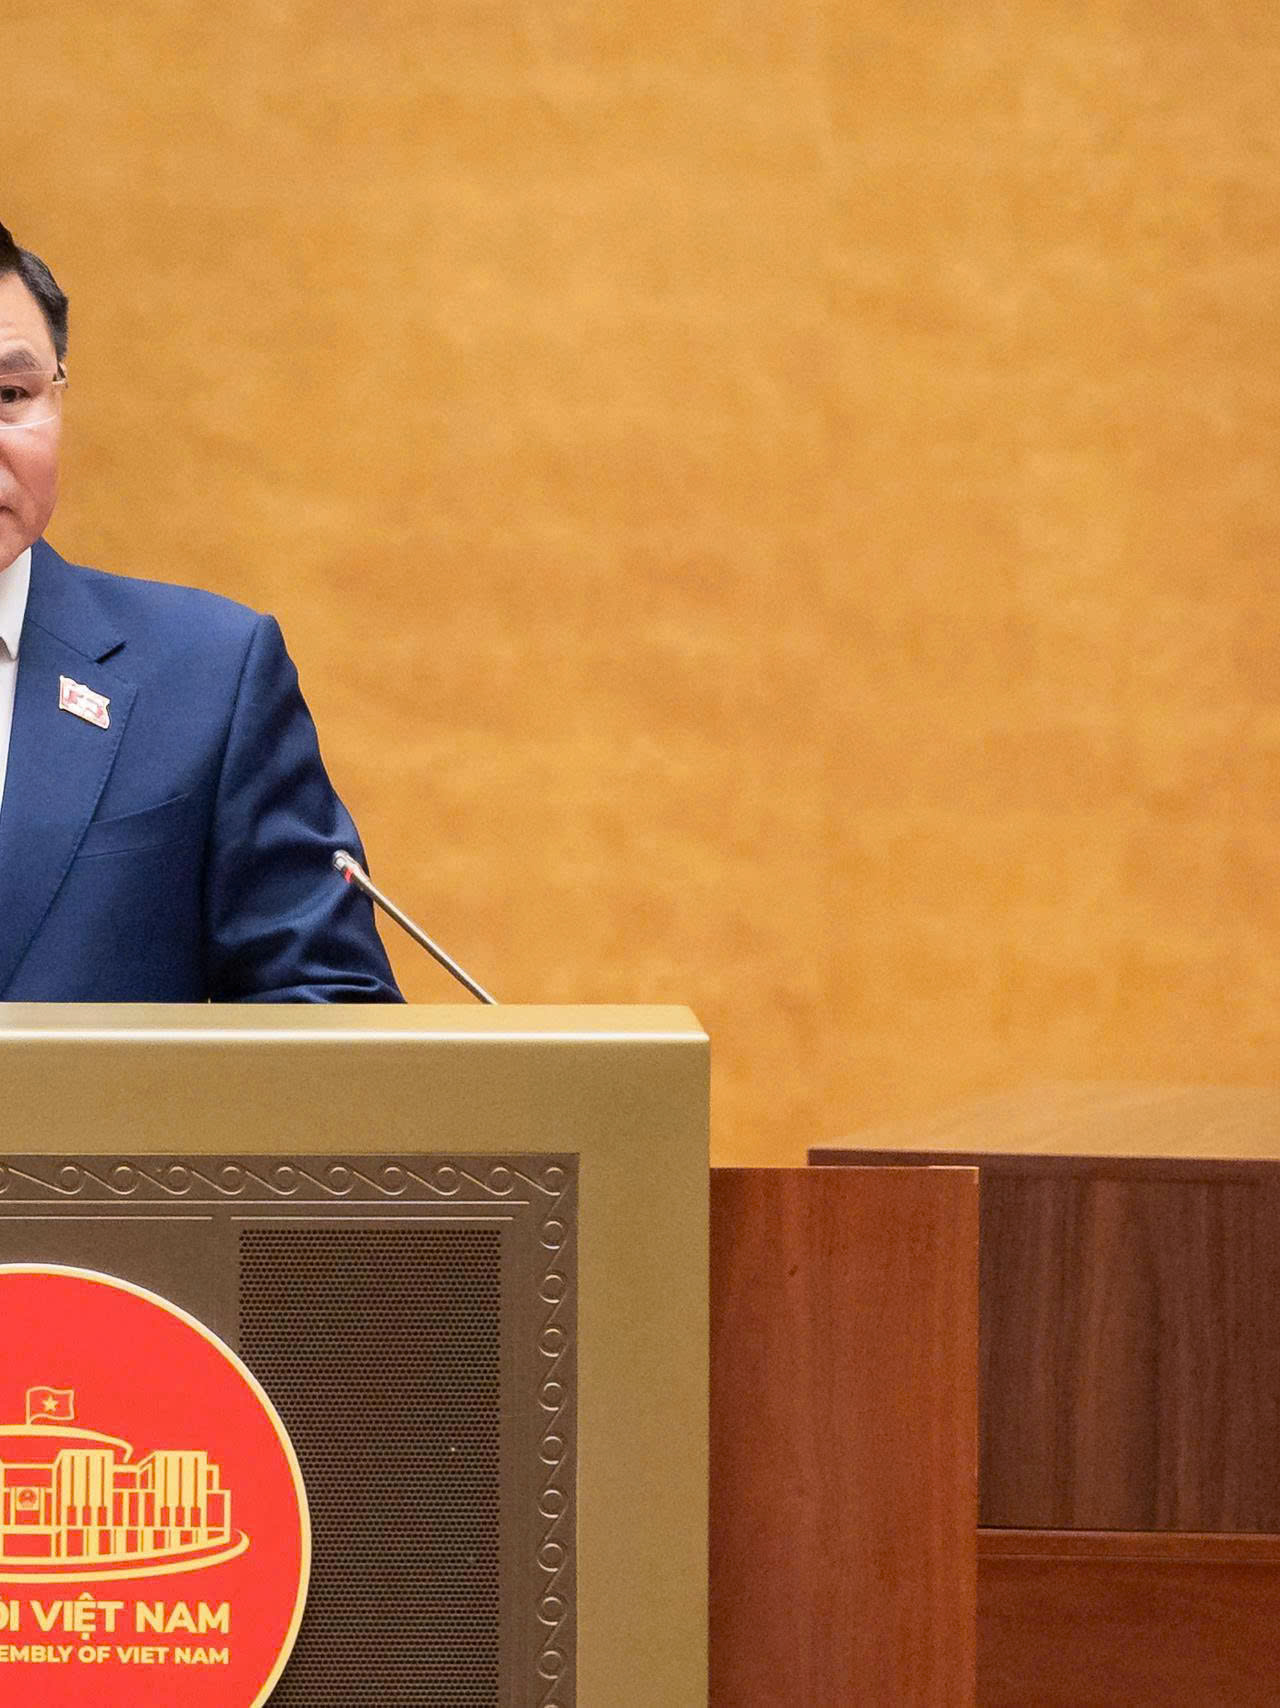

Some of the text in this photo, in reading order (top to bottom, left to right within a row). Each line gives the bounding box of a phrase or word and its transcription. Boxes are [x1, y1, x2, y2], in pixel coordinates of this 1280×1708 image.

[30, 1592, 125, 1641] VIỆT
[135, 1601, 230, 1634] NAM
[77, 1646, 111, 1663] OF
[116, 1647, 170, 1664] VIET
[174, 1647, 229, 1665] NAM
